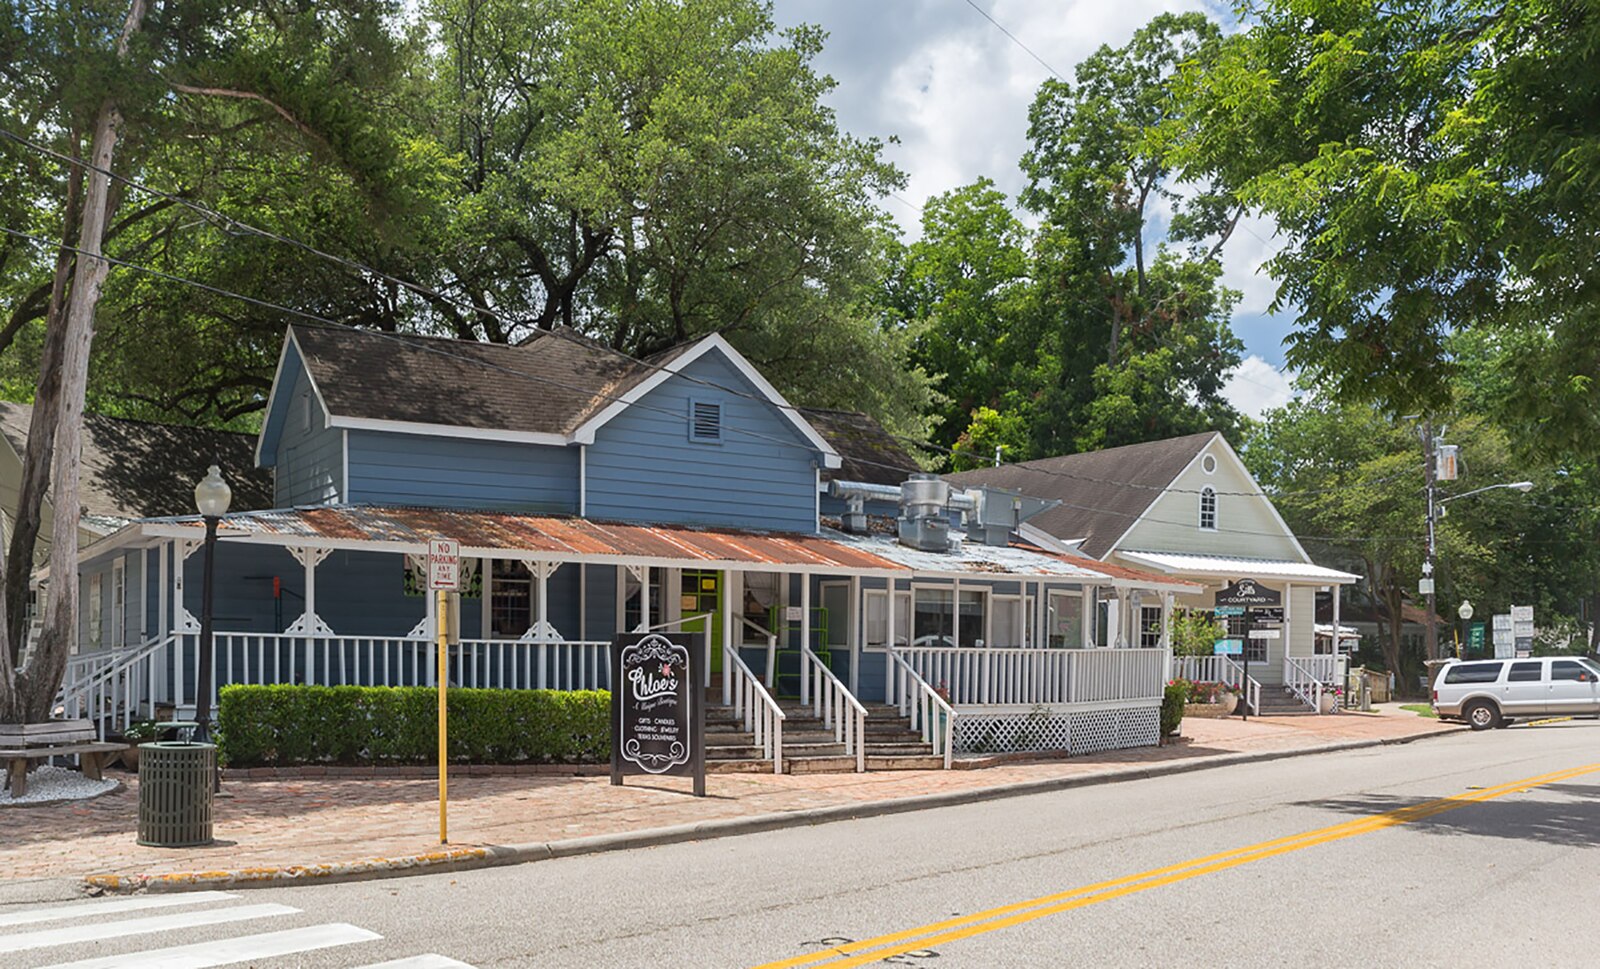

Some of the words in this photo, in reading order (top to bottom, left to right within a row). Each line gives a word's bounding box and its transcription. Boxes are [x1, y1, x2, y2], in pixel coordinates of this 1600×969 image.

[438, 543, 450, 553] NO
[431, 554, 457, 565] PARKING
[437, 572, 451, 580] TIME
[628, 666, 679, 701] Chloe's
[660, 726, 679, 734] JEWELRY
[652, 733, 677, 741] SOUVENIRS
